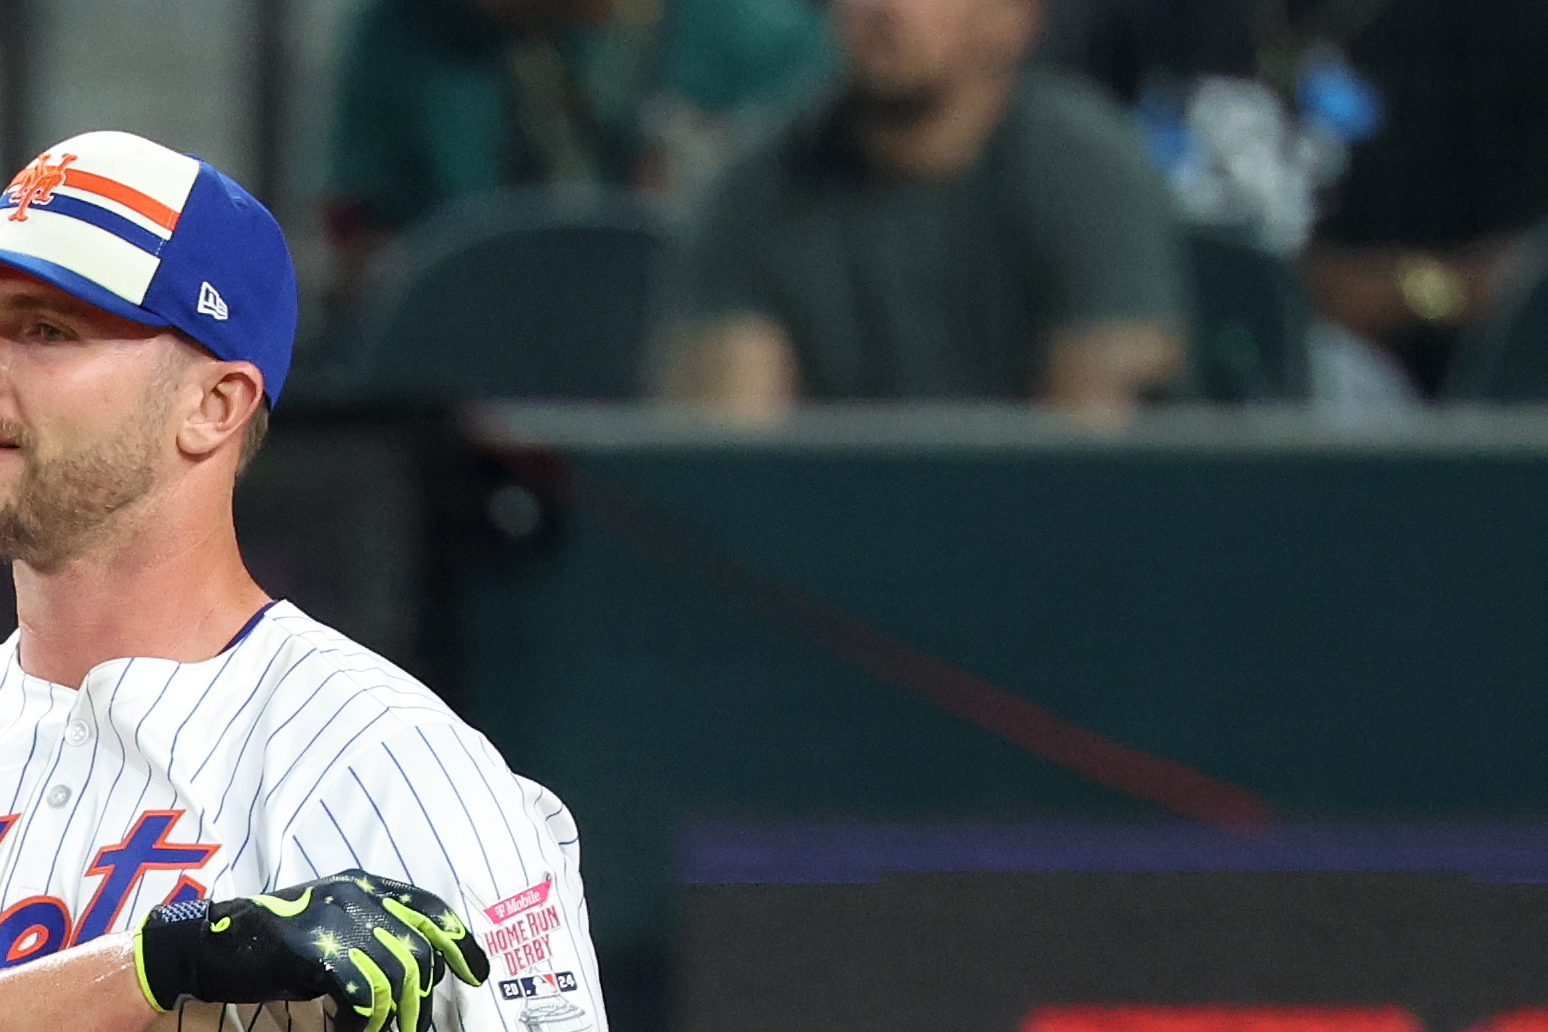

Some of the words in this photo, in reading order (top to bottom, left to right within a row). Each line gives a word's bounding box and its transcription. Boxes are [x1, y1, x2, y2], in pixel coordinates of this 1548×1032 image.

[484, 920, 529, 957] HOME
[526, 905, 561, 937] RUN
[503, 933, 553, 976] DERBY
